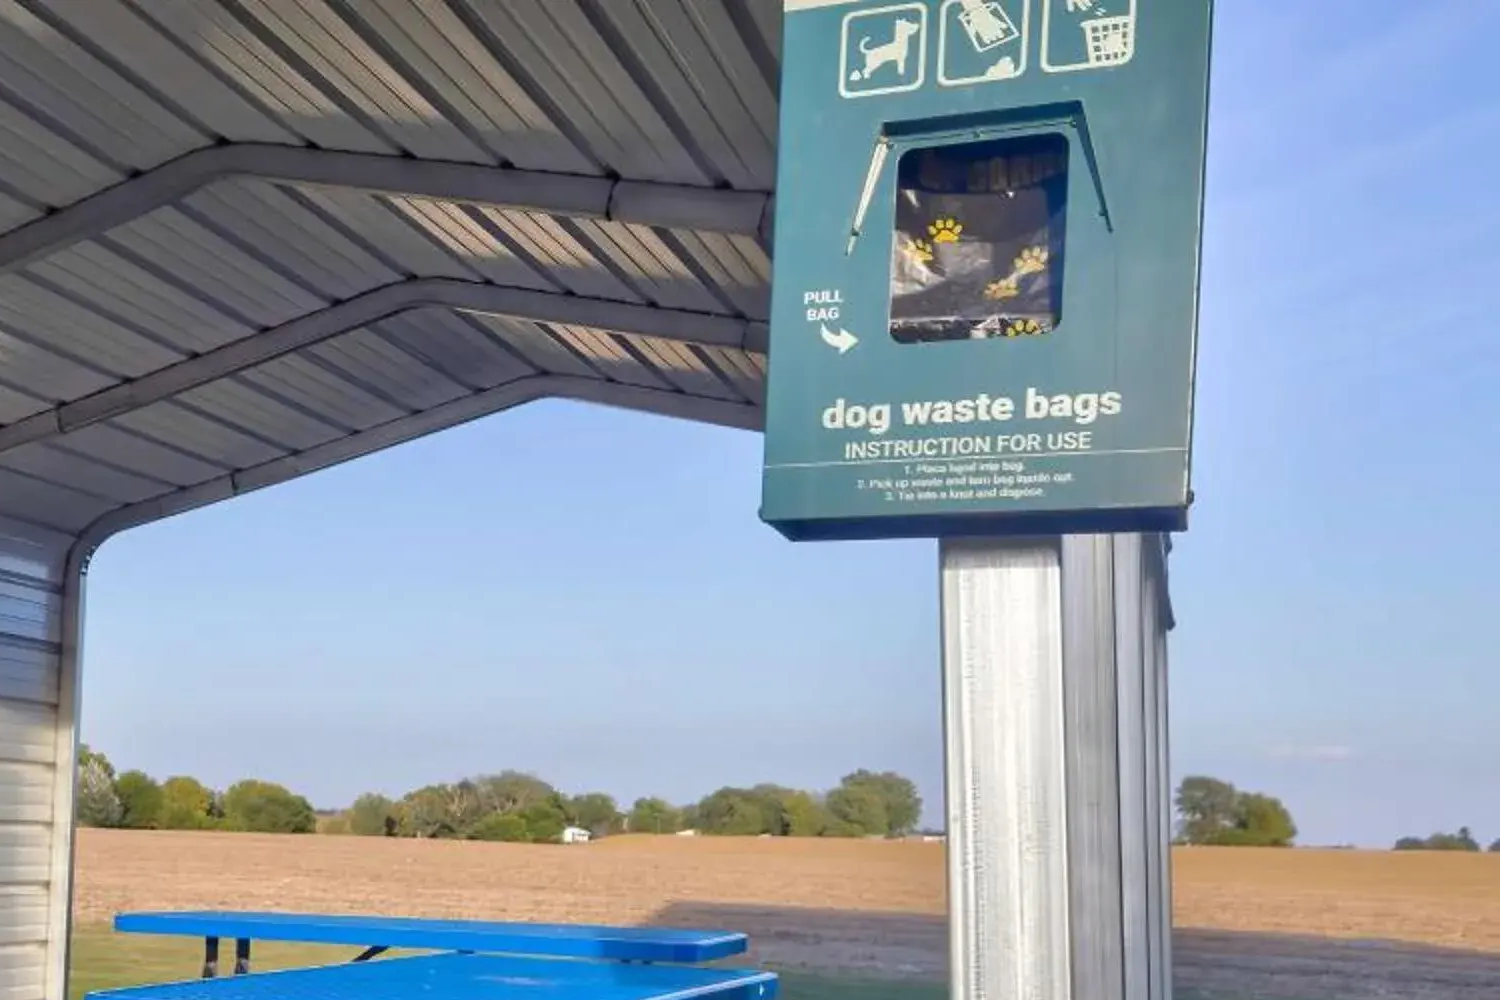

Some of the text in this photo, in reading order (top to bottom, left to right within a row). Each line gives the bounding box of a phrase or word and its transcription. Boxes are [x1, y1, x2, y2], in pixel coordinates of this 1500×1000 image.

[803, 289, 844, 305] PULL
[807, 307, 840, 321] BAG
[822, 387, 1122, 434] dog waste bags
[844, 431, 1093, 460] INSTRUCTION FOR USE
